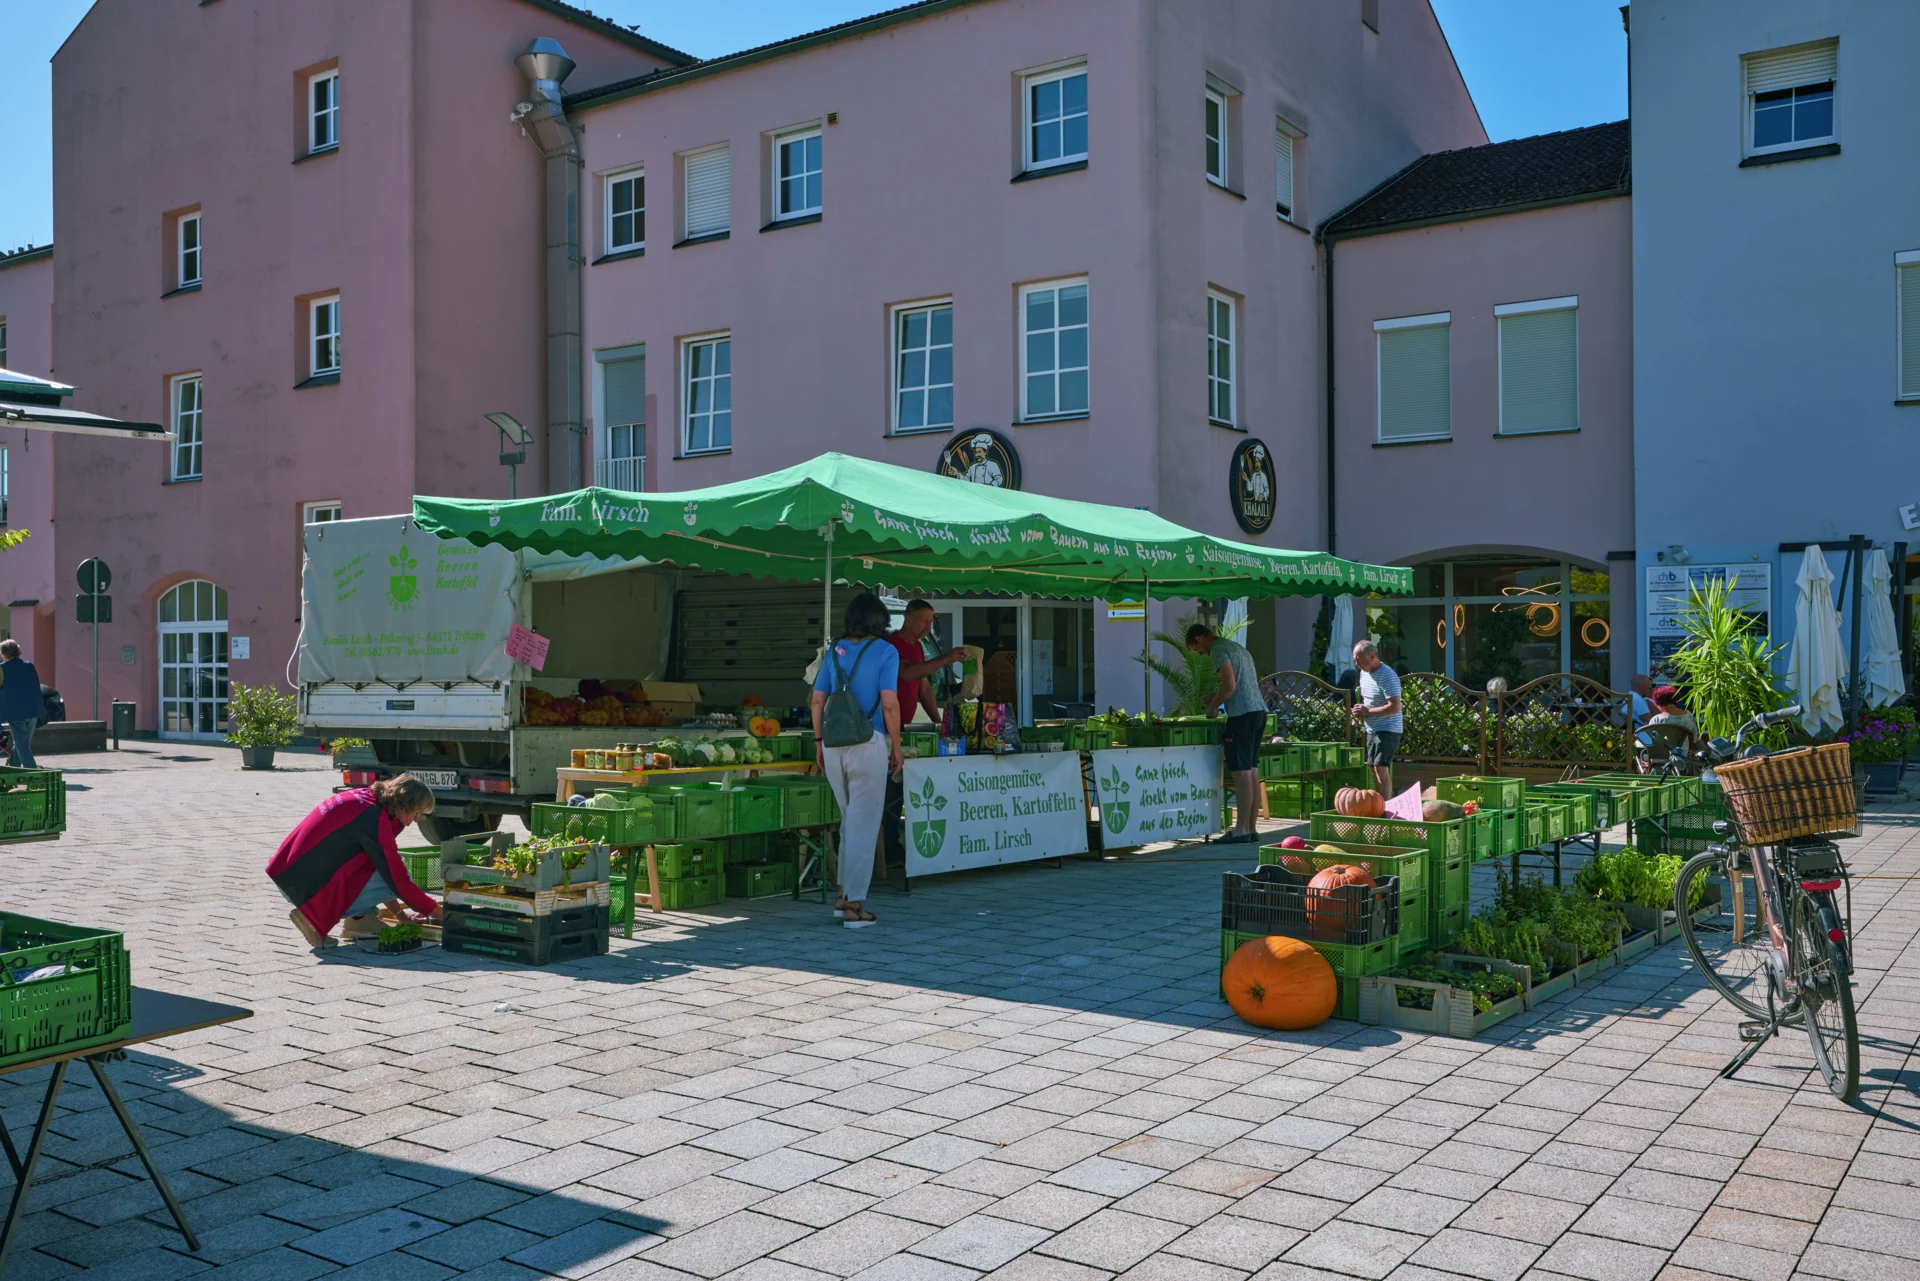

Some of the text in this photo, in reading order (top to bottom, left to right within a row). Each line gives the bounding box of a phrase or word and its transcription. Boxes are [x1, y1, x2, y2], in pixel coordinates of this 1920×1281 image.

[540, 500, 649, 523] Fam. Lirsch
[873, 509, 911, 533] Ganz
[969, 524, 1011, 546] direkt
[1020, 529, 1044, 543] vom
[1050, 525, 1089, 549] Bauern
[1094, 541, 1109, 555] aus
[1114, 539, 1129, 557] der
[436, 560, 478, 573] Beeren
[1203, 545, 1265, 572] Saisongemüse,
[1268, 558, 1300, 576] Beeren,
[435, 576, 479, 591] Kartoffel
[1363, 566, 1398, 584] Fam. Lirsch
[958, 769, 1045, 795] Saisongemüse,
[1135, 761, 1189, 783] Ganz frisch,
[959, 791, 1076, 823] Beeren, Kartoffeln
[1140, 783, 1218, 808] direkt vom Bauern
[1139, 818, 1155, 832] aus
[1159, 812, 1173, 831] der
[959, 828, 1032, 854] Fam. Lirsch
